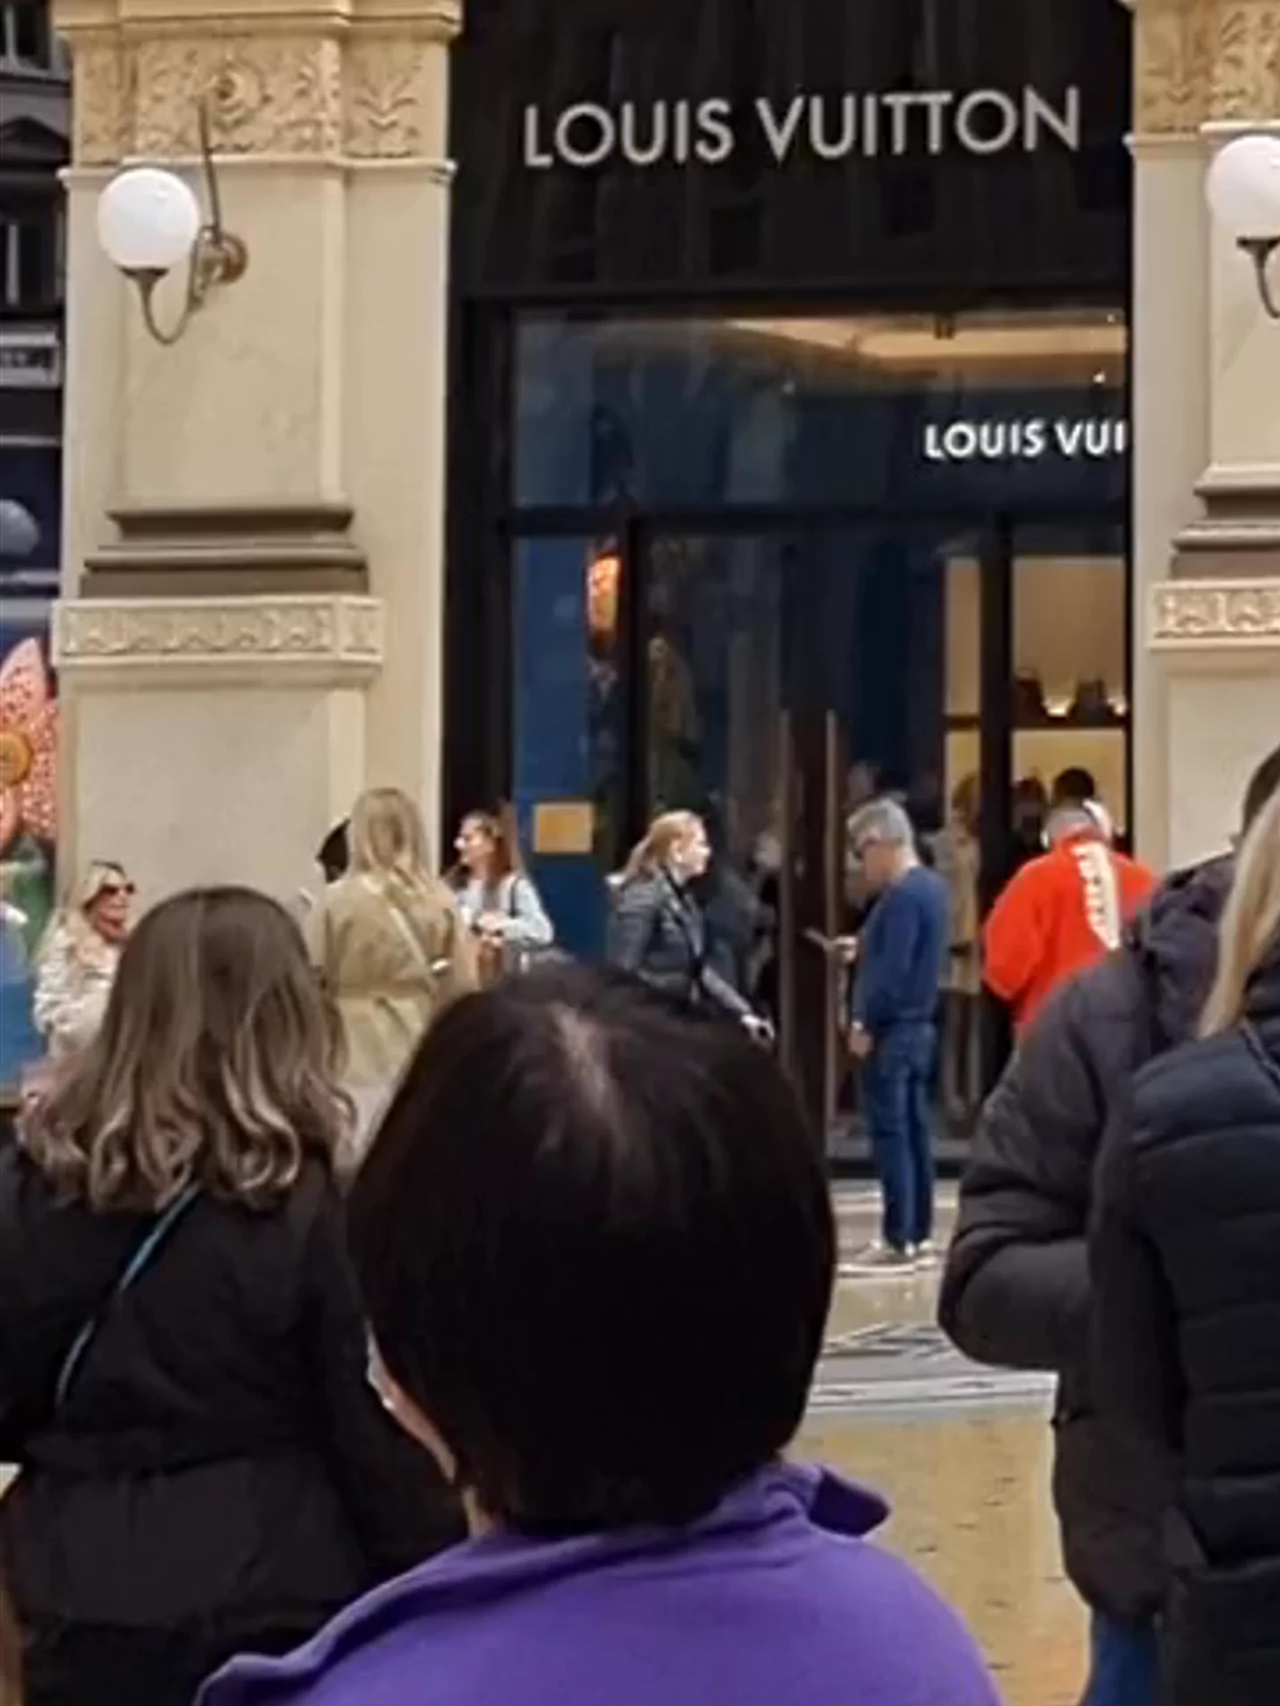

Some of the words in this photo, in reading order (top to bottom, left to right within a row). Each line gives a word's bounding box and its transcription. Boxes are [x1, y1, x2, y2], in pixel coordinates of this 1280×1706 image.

[524, 98, 734, 167] LOUIS
[756, 86, 1080, 164] VUITTON
[925, 418, 1046, 460] LOUIS
